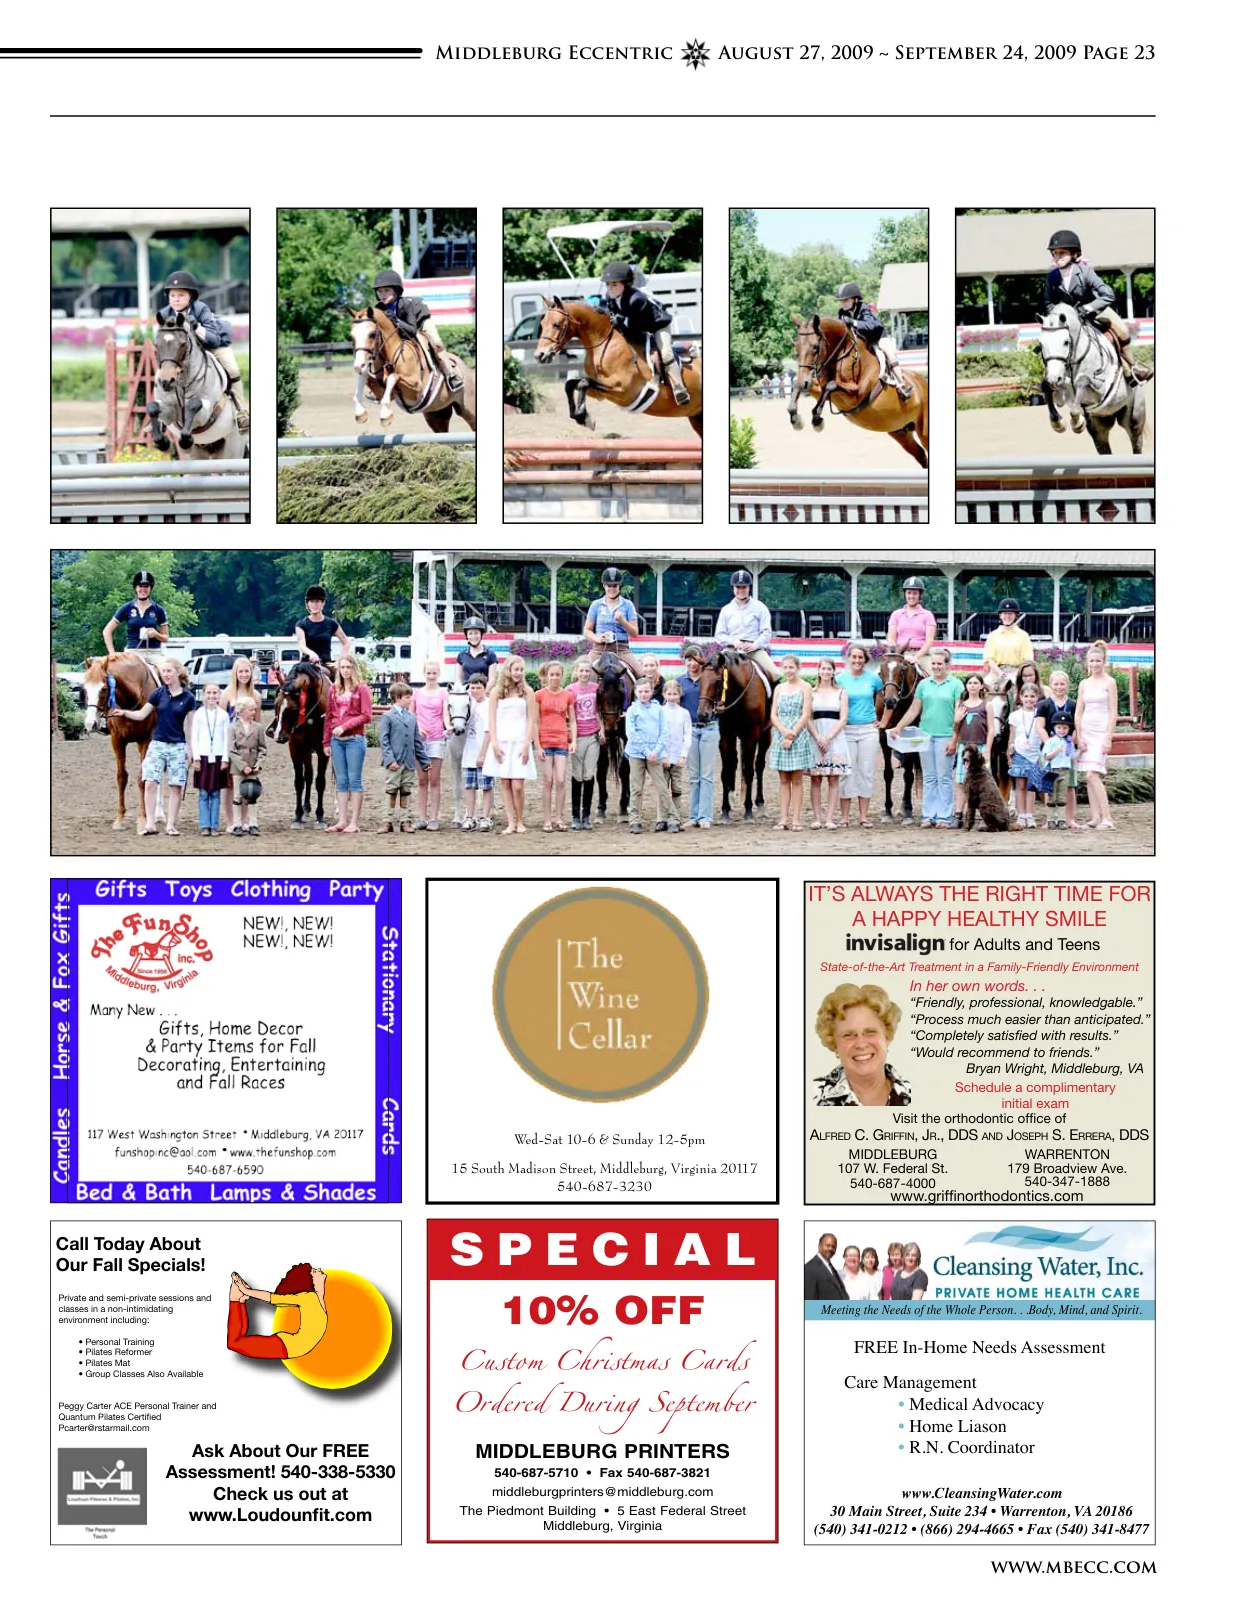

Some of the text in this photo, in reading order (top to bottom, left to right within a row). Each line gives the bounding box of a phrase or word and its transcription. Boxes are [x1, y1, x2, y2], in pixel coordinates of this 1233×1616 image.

[435, 44, 1156, 62] MIDDLEBURG ECCENTRIC AUGUST 27, 2009 SEPTEMBER 24, 2009 PAGE 23
[94, 879, 385, 903] Gifts Toys Clothing Party
[850, 884, 934, 903] ALWAYS
[938, 885, 980, 902] THE
[986, 884, 1049, 903] RIGHT
[1053, 885, 1103, 902] TIME
[1109, 884, 1151, 903] FOR
[90, 928, 125, 959] The
[567, 936, 623, 969] The
[845, 932, 1101, 956] invisalign for Adults and Teens
[567, 981, 640, 1010] Wine
[377, 925, 401, 1157] Stationary Cards
[568, 1017, 653, 1050] Cellar
[52, 1107, 71, 1185] Candles
[513, 1131, 706, 1148] Wed-Sat 10-6 & Sunday 12-5pm
[848, 1148, 938, 1160] MIDDLEBURG
[1024, 1148, 1110, 1160] WARRENTON
[187, 1164, 265, 1176] 540-687-6590
[557, 1180, 653, 1193] 540-687-3230
[849, 1177, 936, 1189] 540-687-4000
[1024, 1175, 1111, 1187] 540-347-1888
[75, 1182, 377, 1203] Bed & Bath Lamps & Shades
[889, 1189, 1084, 1204] www.griffinorthodontics.com
[55, 1236, 202, 1254] Call Today About
[450, 1231, 756, 1267] SPECIAL
[55, 1257, 206, 1276] Our Fall Specials!
[933, 1254, 1144, 1283] Cleansing Water, Inc.
[935, 1287, 1140, 1299] PRIVATE HOME HEALTH CARE
[503, 1294, 705, 1327] 10% OFF
[58, 1423, 150, 1432] Pcarter@rstarmail.com
[475, 1442, 730, 1460] MIDDLEBURG PRINTERS
[492, 1486, 714, 1500] middleburgprinters@middleburg.com
[901, 1486, 1063, 1502] www.CleansingWater.com
[188, 1507, 373, 1523] www.Loudounfit.com
[990, 1560, 1158, 1575] WWW.MBECC.COM
